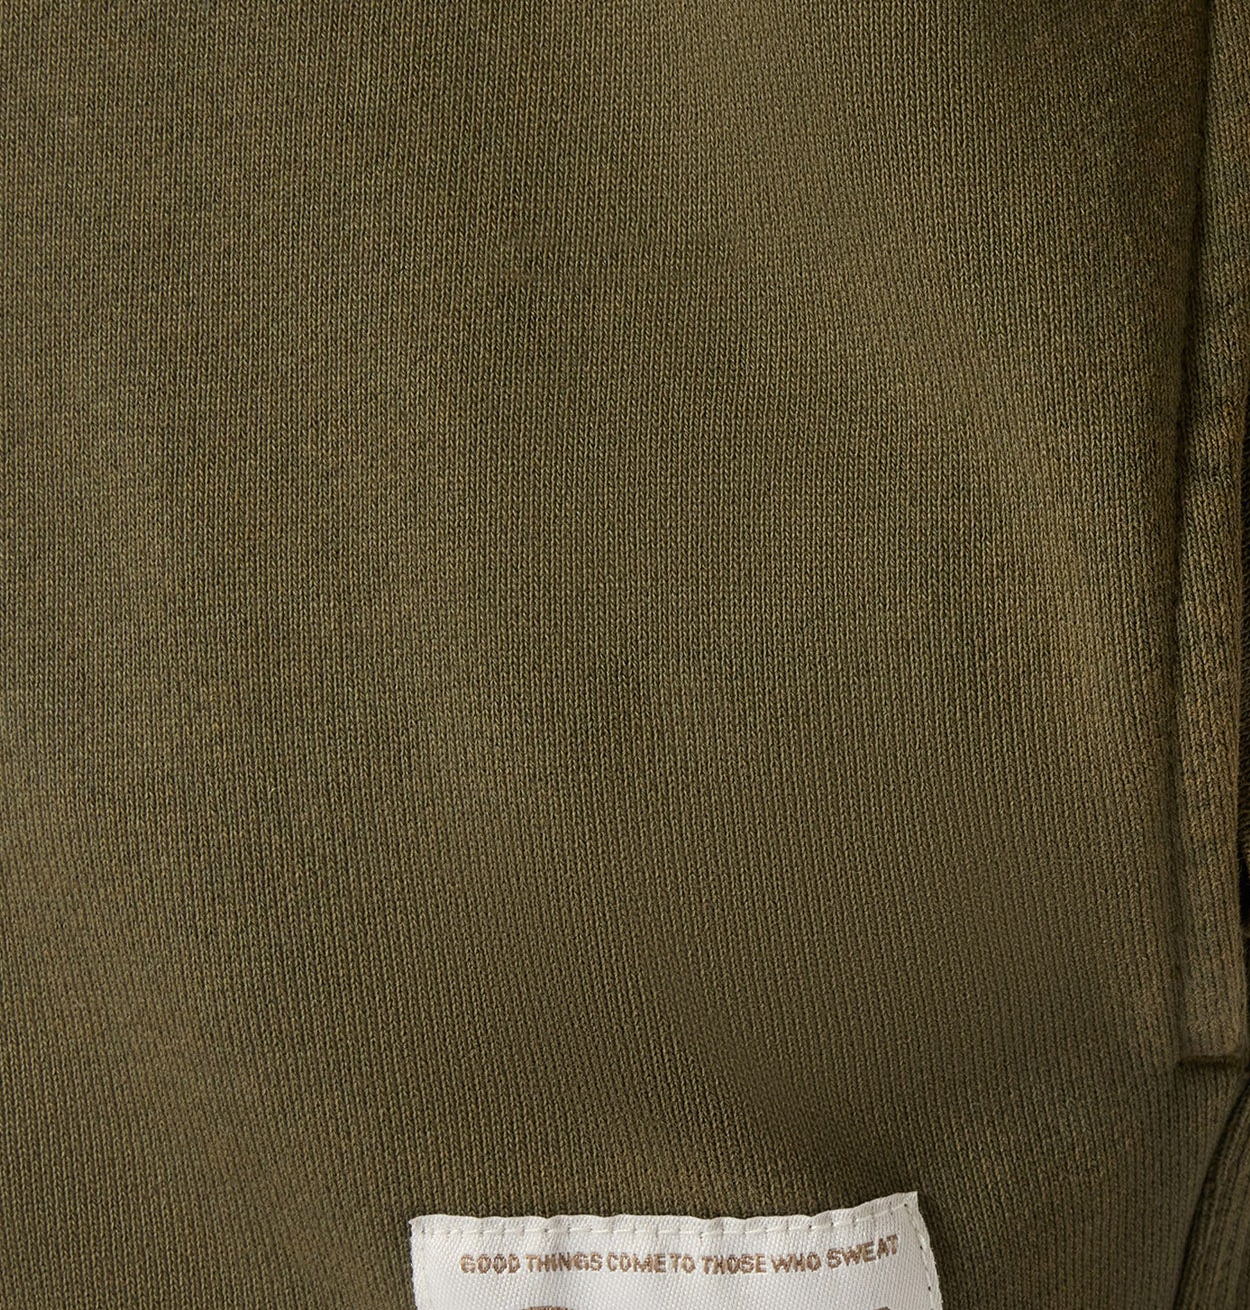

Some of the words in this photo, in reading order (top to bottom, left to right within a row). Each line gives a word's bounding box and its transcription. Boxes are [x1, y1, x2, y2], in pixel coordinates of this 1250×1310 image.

[460, 1254, 521, 1274] GOOD
[525, 1252, 602, 1274] THINGS
[606, 1252, 667, 1274] COME
[670, 1253, 696, 1274] TO
[701, 1253, 768, 1275] THOSE
[770, 1252, 822, 1274] WHO
[826, 1234, 899, 1269] SWEAT
